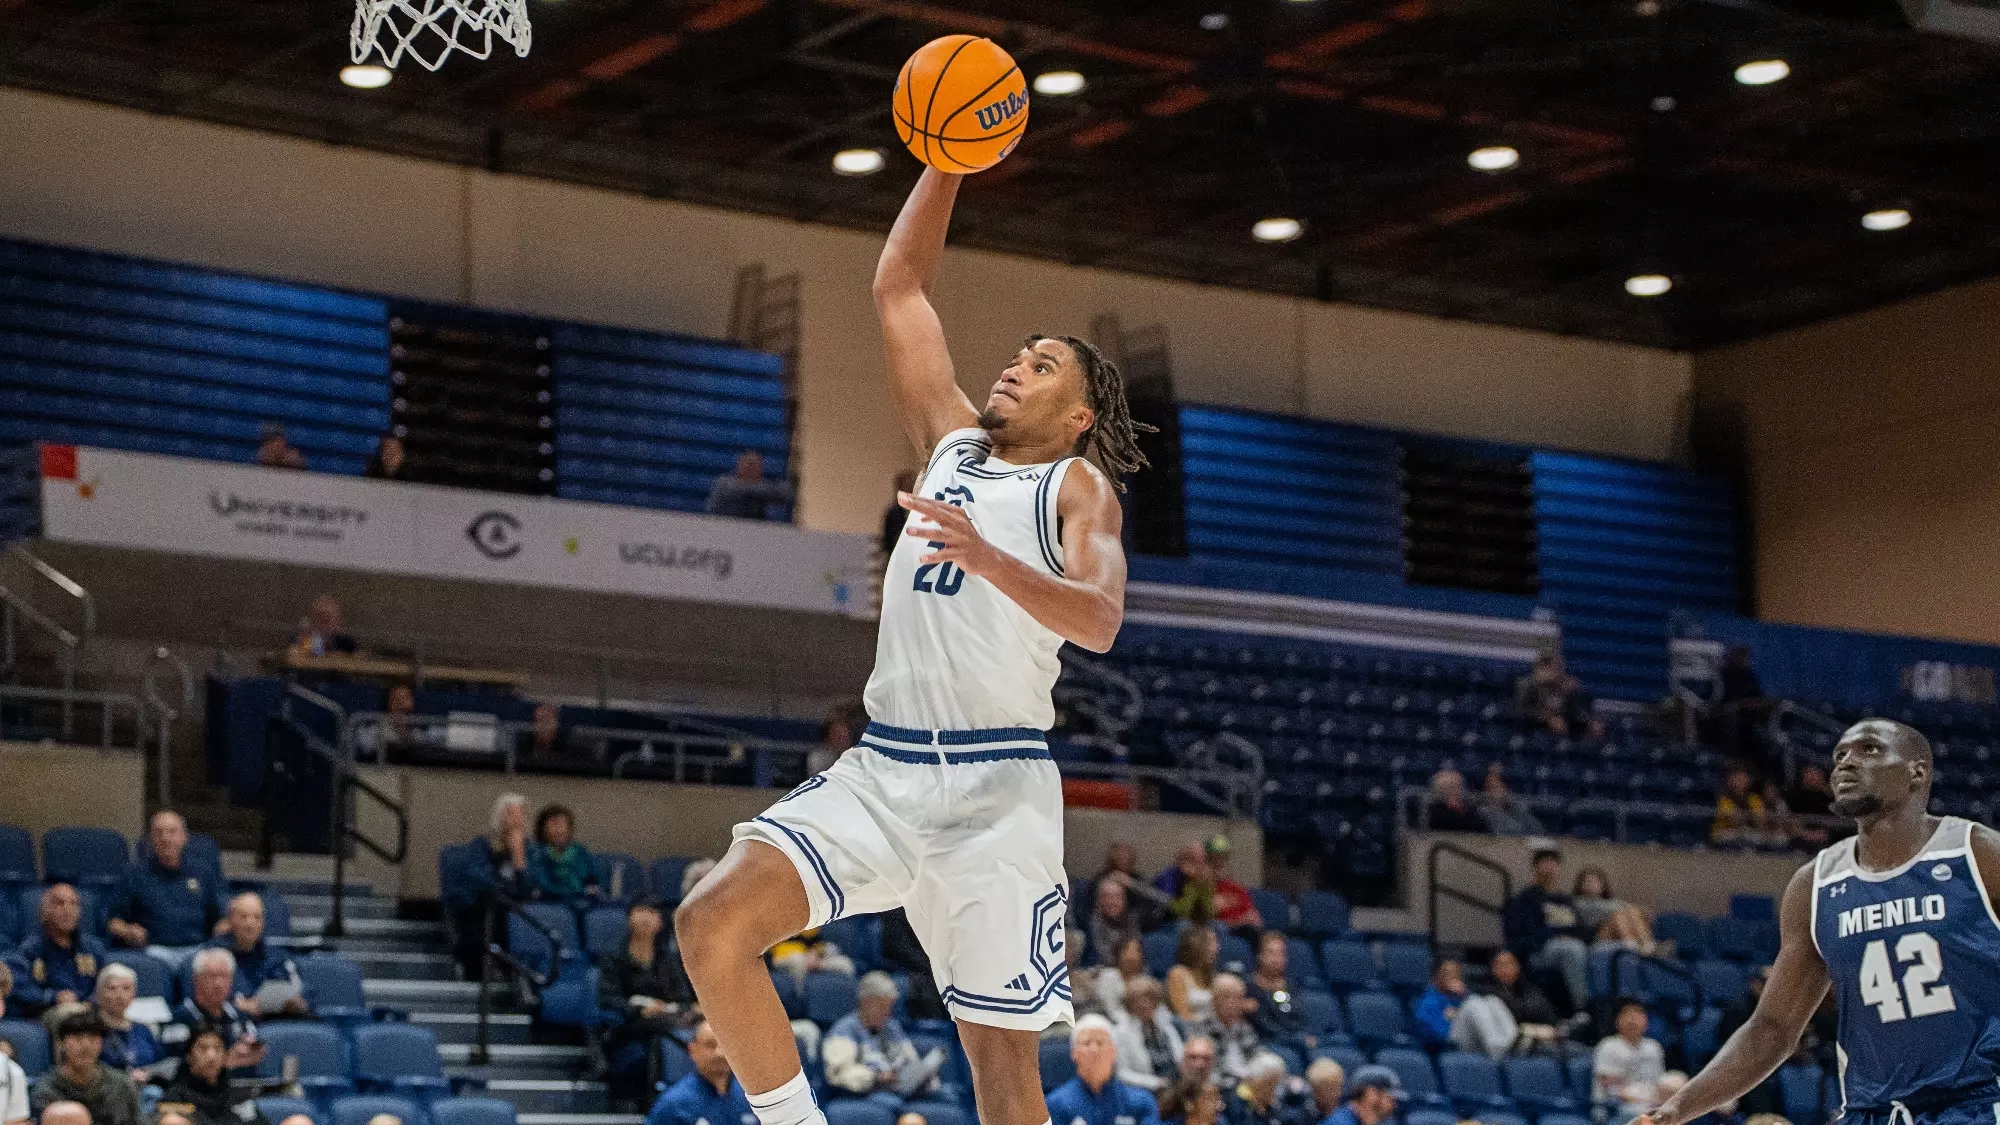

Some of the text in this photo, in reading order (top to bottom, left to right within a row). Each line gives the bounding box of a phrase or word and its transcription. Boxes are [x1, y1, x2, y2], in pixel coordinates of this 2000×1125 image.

[974, 88, 1029, 130] Wilso
[618, 542, 733, 580] ucu.org
[1838, 894, 1946, 937] MENLO
[1859, 932, 1956, 1024] 42
